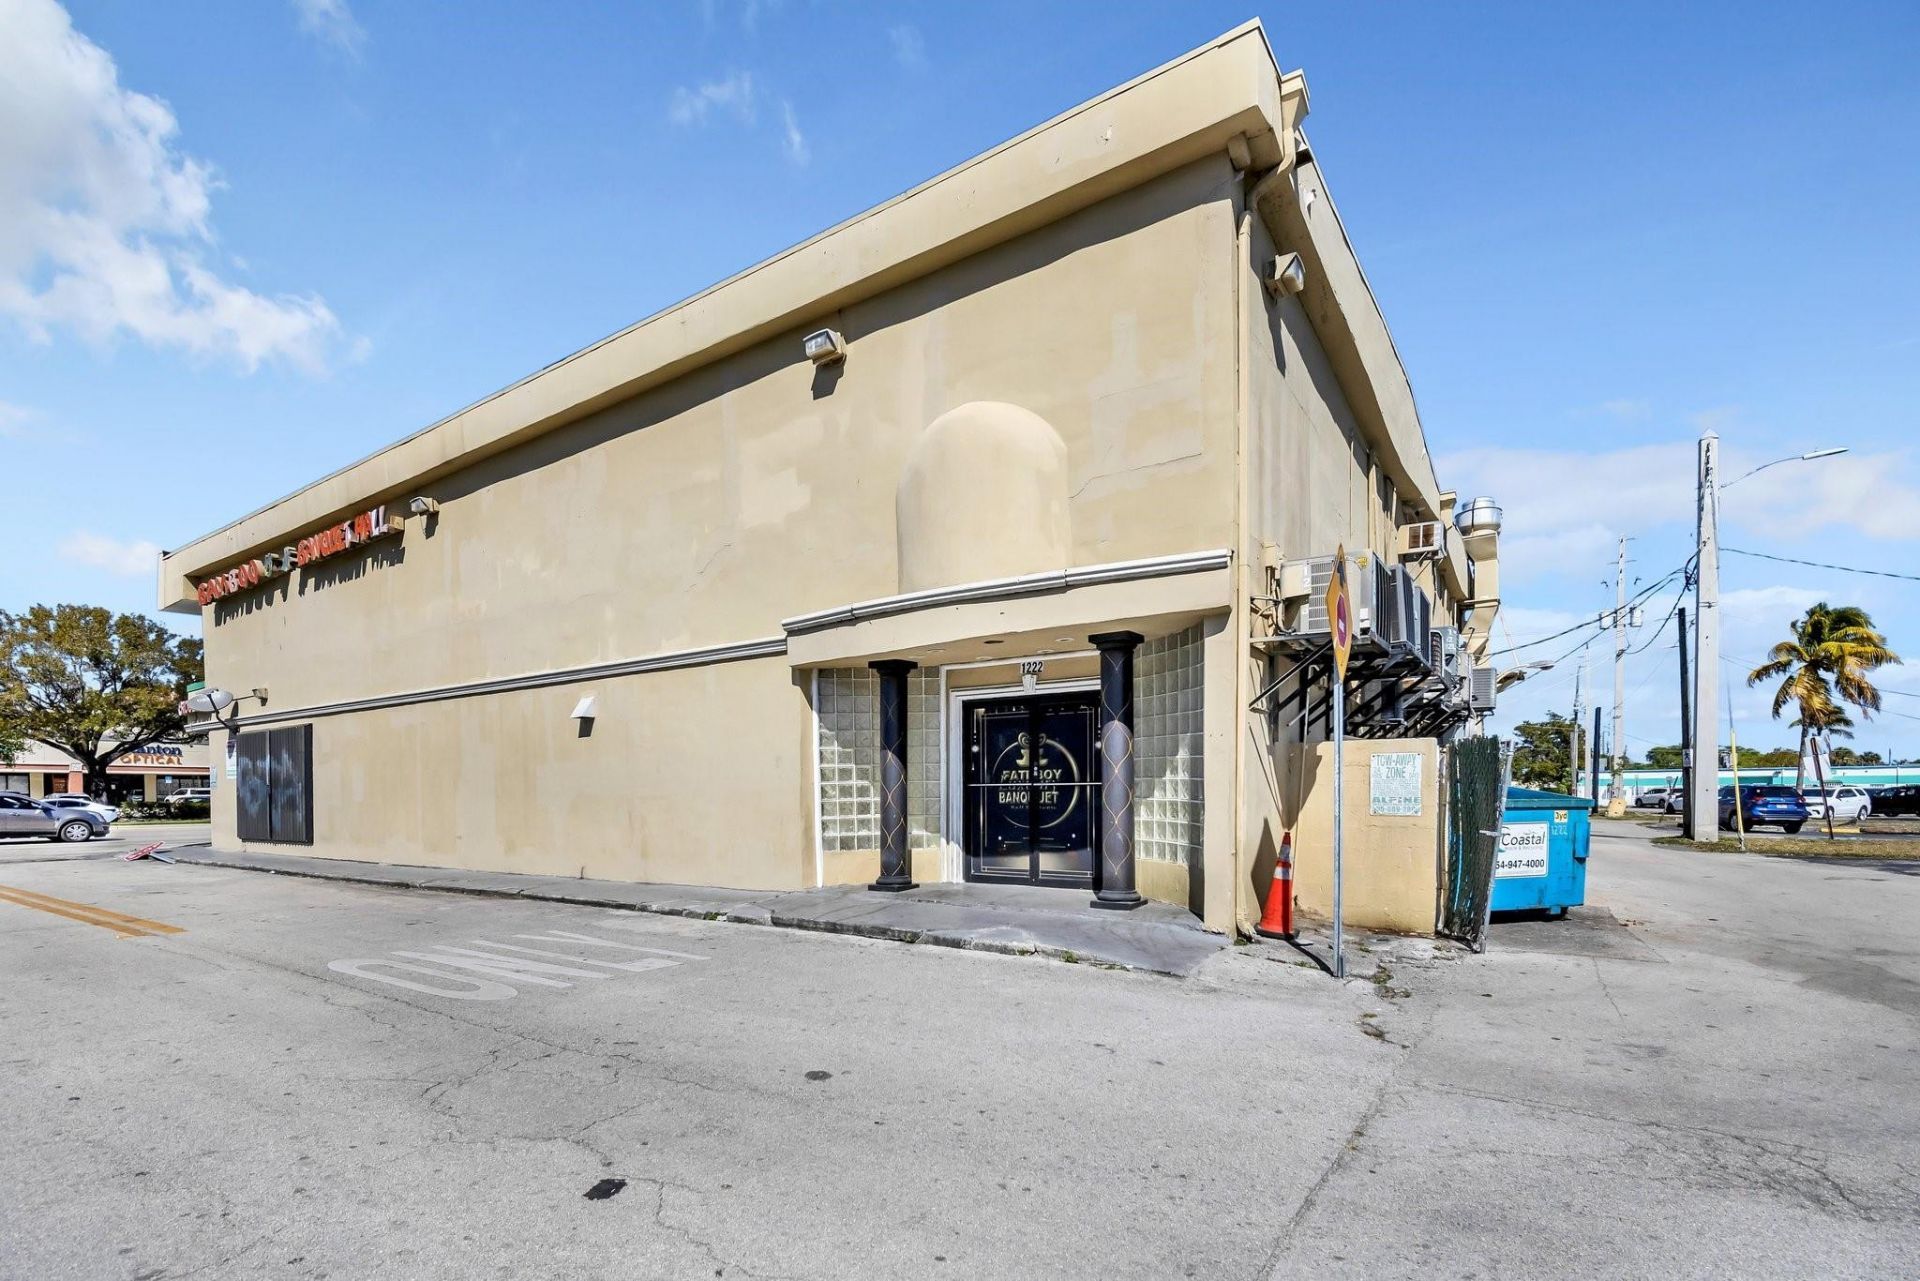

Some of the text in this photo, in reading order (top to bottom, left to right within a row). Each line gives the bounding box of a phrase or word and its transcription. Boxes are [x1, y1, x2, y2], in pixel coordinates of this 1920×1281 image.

[1022, 661, 1043, 674] 1222
[120, 754, 182, 766] OPTICAL
[1386, 766, 1406, 779] ZONE
[1501, 831, 1546, 847] Coastal
[1495, 858, 1545, 870] 54-947-4000
[327, 930, 712, 1001] ONLY
